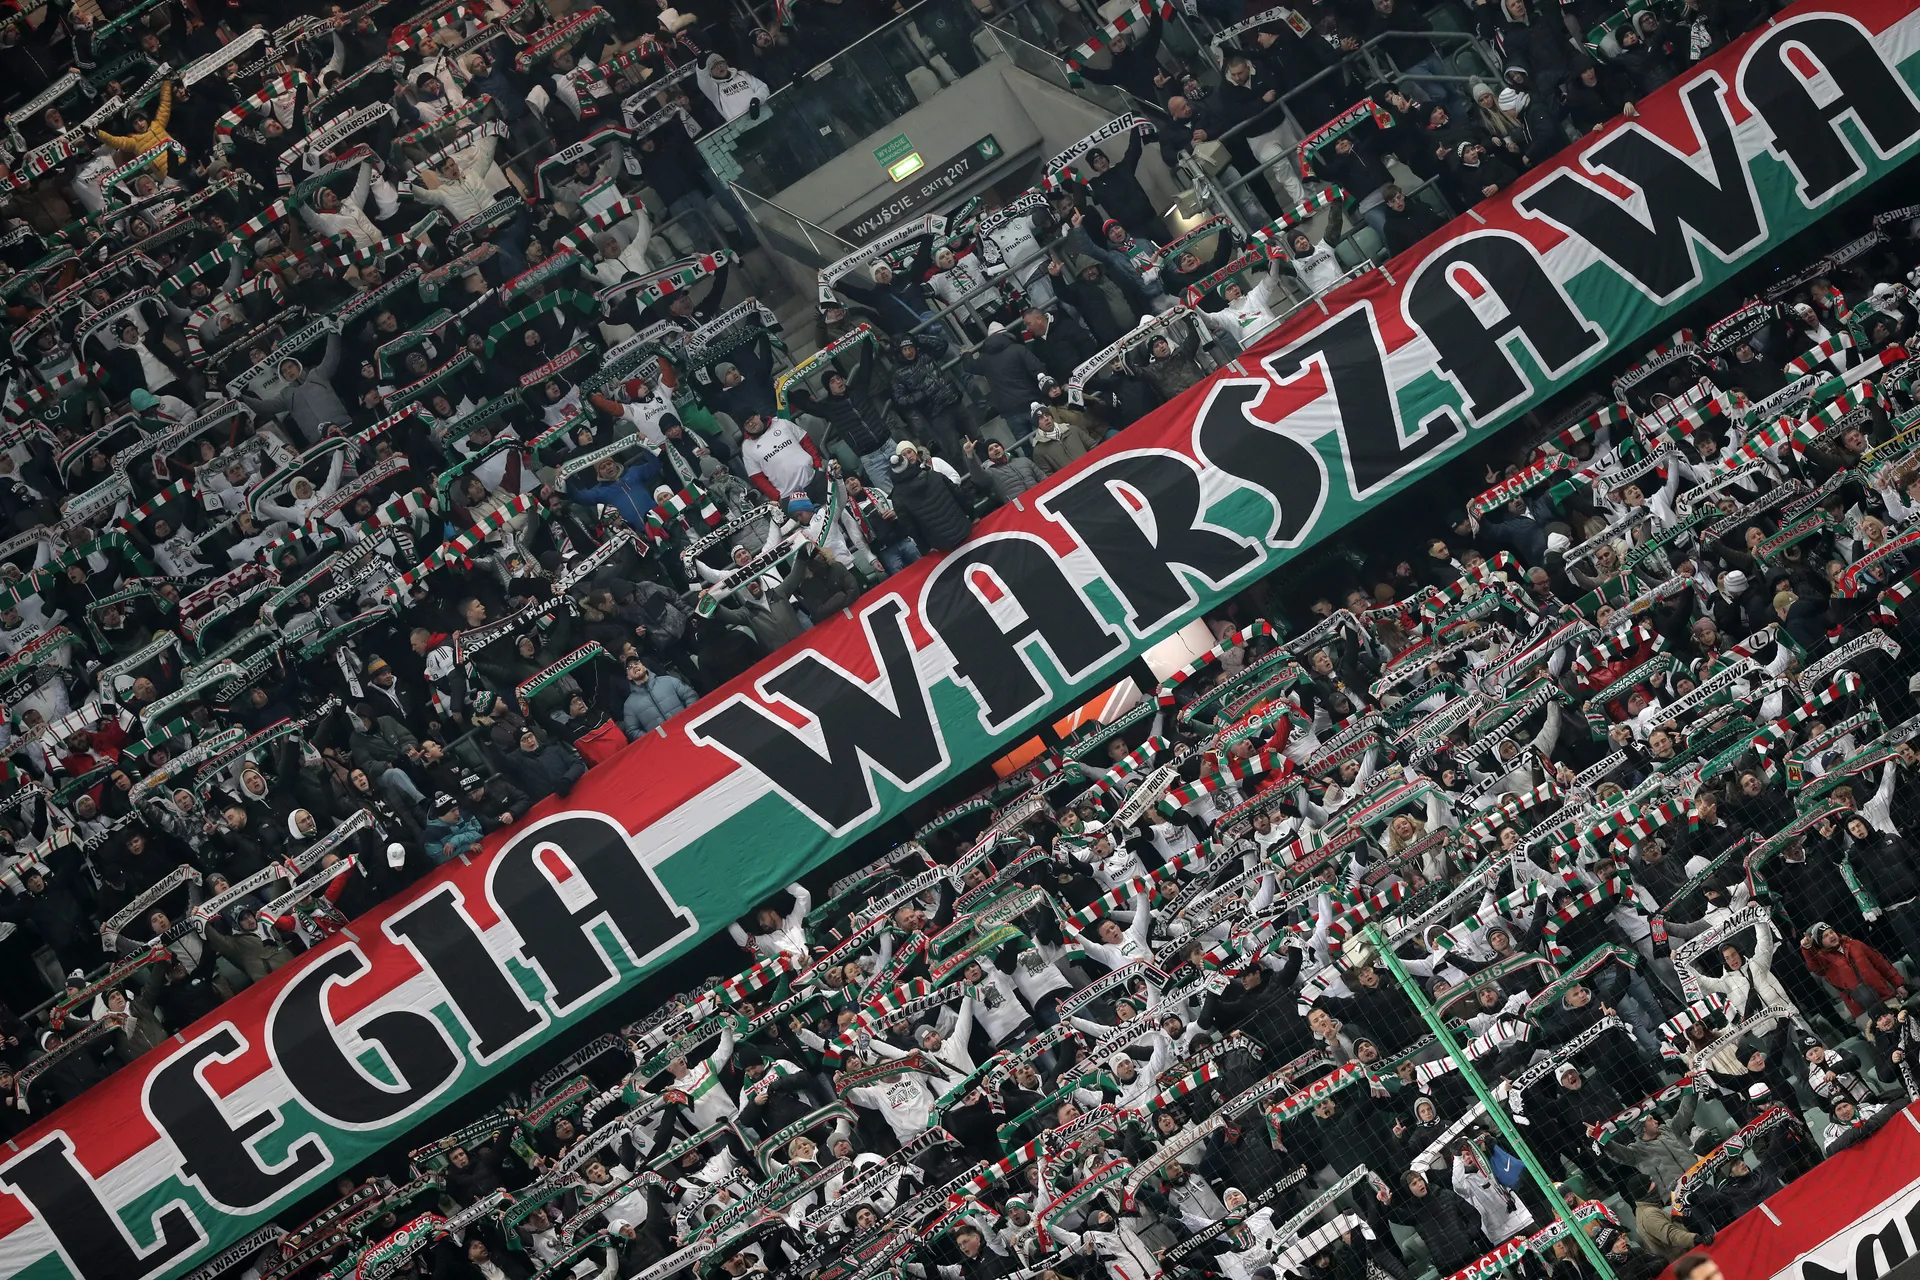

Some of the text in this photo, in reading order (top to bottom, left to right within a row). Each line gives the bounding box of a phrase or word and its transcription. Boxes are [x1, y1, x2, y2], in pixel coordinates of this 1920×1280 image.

[533, 14, 598, 58] KAZIU DEYNA
[1216, 9, 1274, 40] WAWER
[313, 104, 388, 152] LEGIA WARSZAWA
[420, 101, 481, 137] LEGIA
[1308, 103, 1371, 147] MARKI
[559, 144, 583, 161] 1916
[876, 137, 906, 159] WYJŚCIE
[1051, 114, 1133, 170] CWKS LEGIA
[854, 162, 969, 238] WYJŚCIE EXIT 207
[1005, 233, 1032, 253] Plus500
[648, 252, 725, 298] CWKS
[1201, 249, 1263, 290] LEGIA
[1303, 253, 1331, 274] FORTUNA
[344, 288, 389, 317] WARSAW
[390, 267, 418, 291] FANS
[1766, 276, 1797, 293] ULTRAS
[1704, 312, 1771, 355] ULTRAS LEGIA
[232, 365, 264, 390] LEGIA
[264, 321, 325, 368] WARSZAWA
[447, 349, 472, 371] LEGIA
[521, 349, 579, 385] CWKS LEGIA
[781, 326, 870, 392] DEN HAAG WARSZAWA LEGIA
[1622, 363, 1646, 386] LEGIA
[1766, 376, 1817, 409] WARSZAWA
[763, 439, 793, 463] Plus500
[1876, 442, 1903, 462] DEN
[318, 460, 397, 513] MISTRZ POLSKI
[1487, 466, 1546, 510] LEGIA
[1608, 462, 1638, 484] LEGIA
[1705, 460, 1764, 490] WARSZAWA
[69, 492, 89, 509] LEGIA
[562, 530, 624, 589] WOLA
[722, 539, 794, 589] URSUS
[179, 564, 260, 612] LEGIA
[527, 596, 565, 621] PIJACY
[0, 11, 1920, 1280] LEGIA WARSZAWA
[11, 625, 40, 646] MIASTO
[32, 630, 66, 655] LEGIA
[241, 648, 270, 670] LEGIA
[1387, 663, 1426, 683] LEGIA
[171, 664, 232, 702] WARSZAWA
[216, 659, 273, 704] ULTRAS LEGIA
[523, 672, 550, 695] LEGIA
[1650, 663, 1750, 728] LEGIA WARSZAWA
[1070, 705, 1152, 759] RADOMIAK RADOM
[1218, 724, 1245, 751] DEYNA
[1118, 767, 1169, 824] MISTRZ POLSKI
[1460, 751, 1533, 806] STOLICA
[1342, 797, 1373, 820] 1916
[1650, 787, 1680, 810] LEGIO
[1293, 829, 1360, 875] CWKS LEGIA
[1515, 836, 1531, 863] LEGIA
[151, 867, 186, 895] AWIACY
[835, 868, 870, 890] LEGIA
[1110, 858, 1138, 882] Plus500
[864, 867, 940, 917] LEGIA WARSZAWA
[984, 889, 1041, 925] CWKS LEGIA
[1186, 862, 1268, 917] LEGIA WARSZAWA
[1285, 889, 1305, 904] DEN
[1411, 881, 1484, 930] WARSZAWA
[812, 926, 876, 978] JÓZEFÓW
[1153, 900, 1249, 966] LEGIO NISCI
[861, 935, 924, 1003] CWKS LEGIA
[933, 953, 970, 981] LEGIA
[1466, 966, 1503, 990] 1916
[1676, 940, 1699, 981] WARSZ
[1075, 993, 1099, 1012] LEGII
[1004, 1053, 1026, 1076] JEST
[1023, 1031, 1058, 1058] ZAWSZE
[1513, 1024, 1605, 1092] LEGIO NISCI
[538, 1065, 568, 1092] LEGIA
[1064, 1064, 1083, 1086] NIE
[1279, 1068, 1355, 1118] LEGIA
[1602, 1082, 1681, 1132] 1916
[667, 1134, 703, 1159] 1916
[774, 1121, 806, 1146] 1916
[710, 1210, 739, 1234] LEGIA
[741, 1167, 797, 1213] WARSZAWA
[805, 1197, 842, 1225] WARSZ
[862, 1163, 901, 1195] AWIACY
[894, 1166, 985, 1230] NIE PODDAWAJ
[300, 1192, 363, 1236] WARKA
[211, 1229, 279, 1272] WARSZAWA
[276, 1239, 330, 1278] WARKA
[362, 1241, 394, 1269] DEYNA
